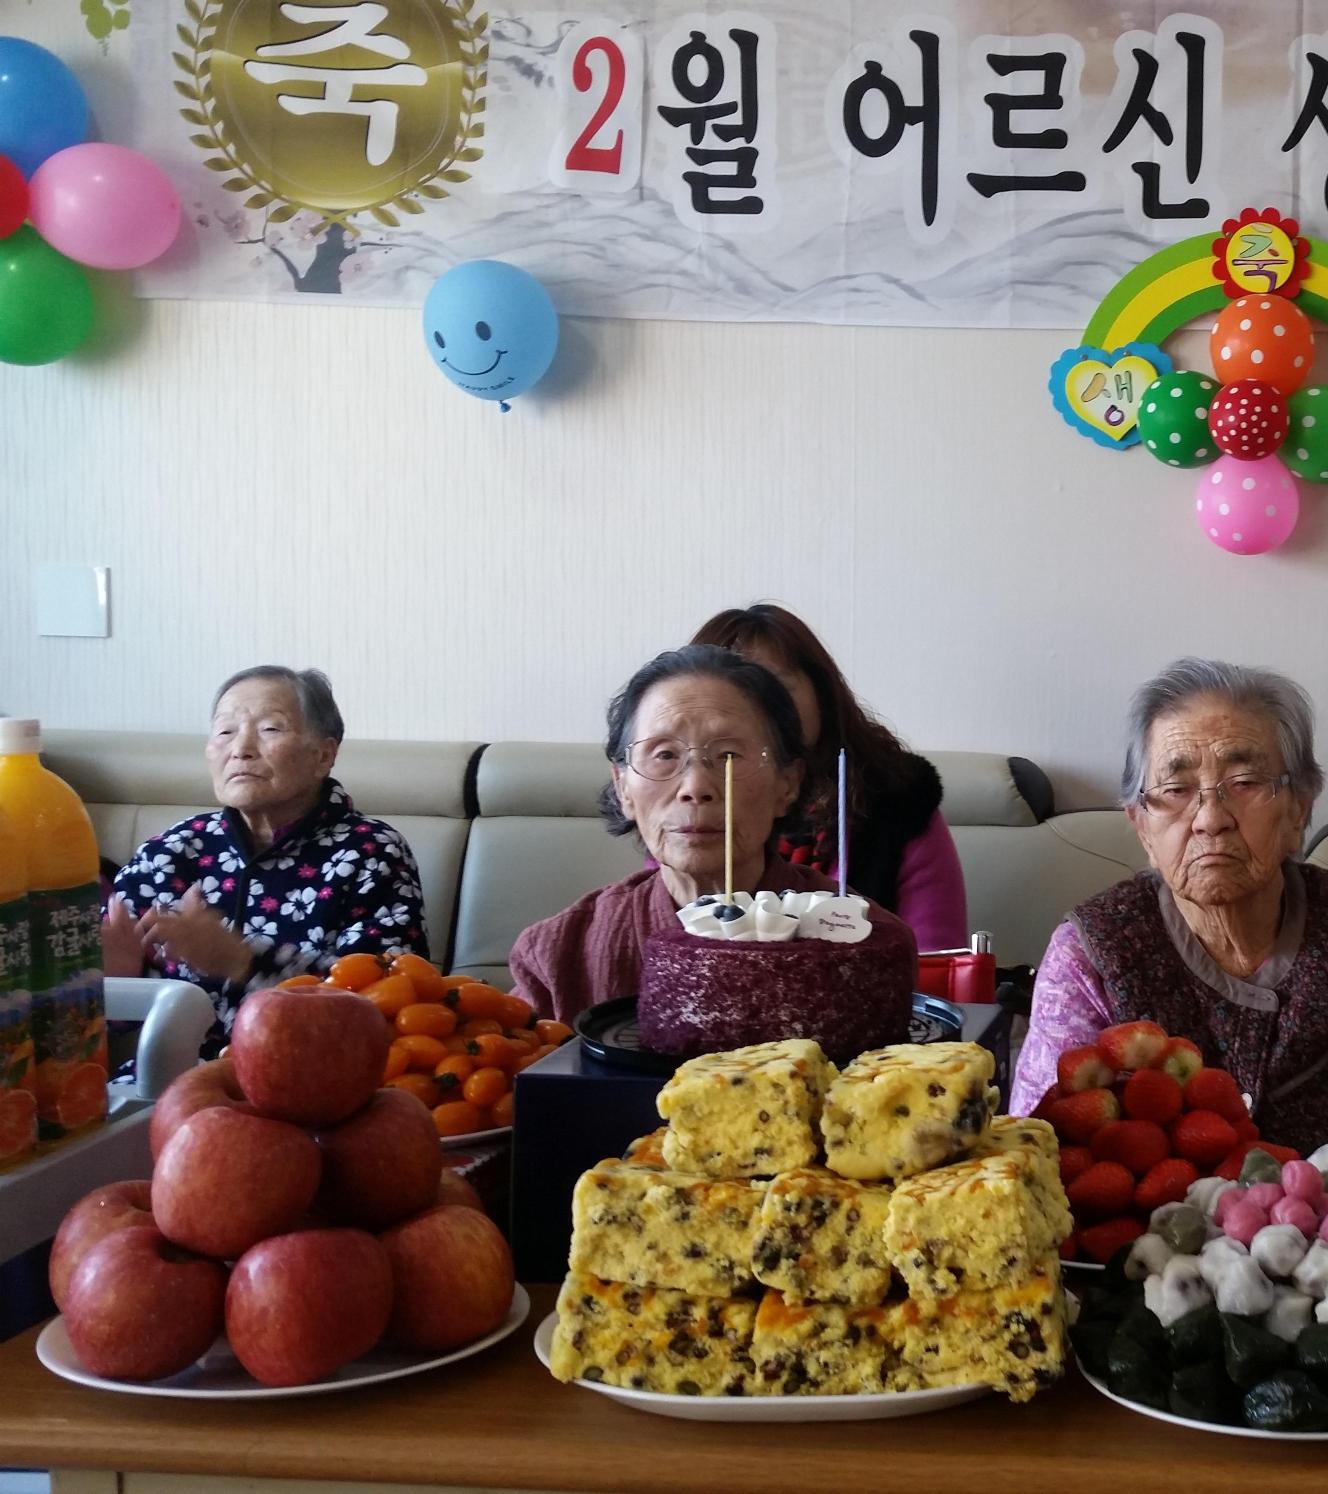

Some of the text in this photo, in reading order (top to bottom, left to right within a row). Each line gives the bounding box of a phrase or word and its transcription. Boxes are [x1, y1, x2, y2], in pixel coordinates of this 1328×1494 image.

[564, 27, 764, 215] 2월
[842, 29, 1210, 227] 어르신
[1231, 222, 1290, 293] 축
[1080, 369, 1134, 427] 생
